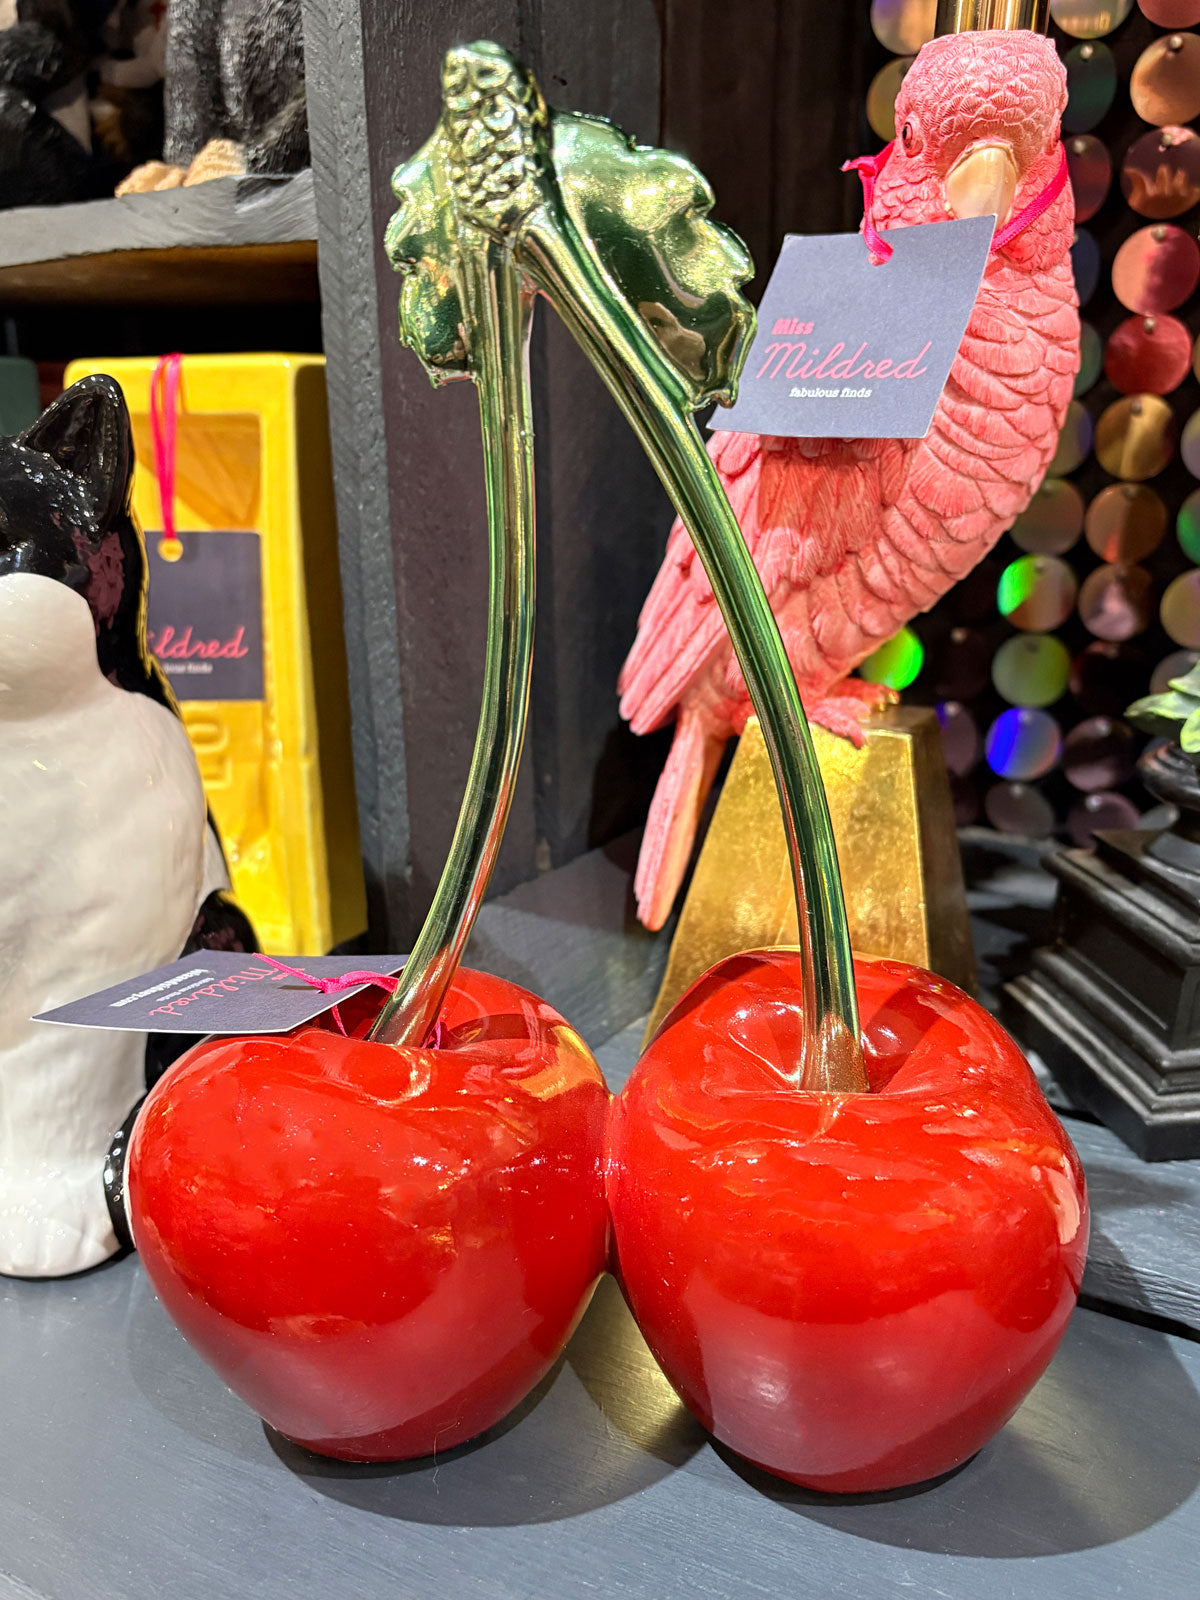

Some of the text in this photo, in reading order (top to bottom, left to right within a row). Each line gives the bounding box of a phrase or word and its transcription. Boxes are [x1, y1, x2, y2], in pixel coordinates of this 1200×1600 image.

[771, 317, 815, 335] Miss
[756, 341, 933, 379] Mildred
[789, 387, 872, 398] fabulous finds
[147, 625, 249, 659] ldred
[148, 967, 279, 1016] Mildred
